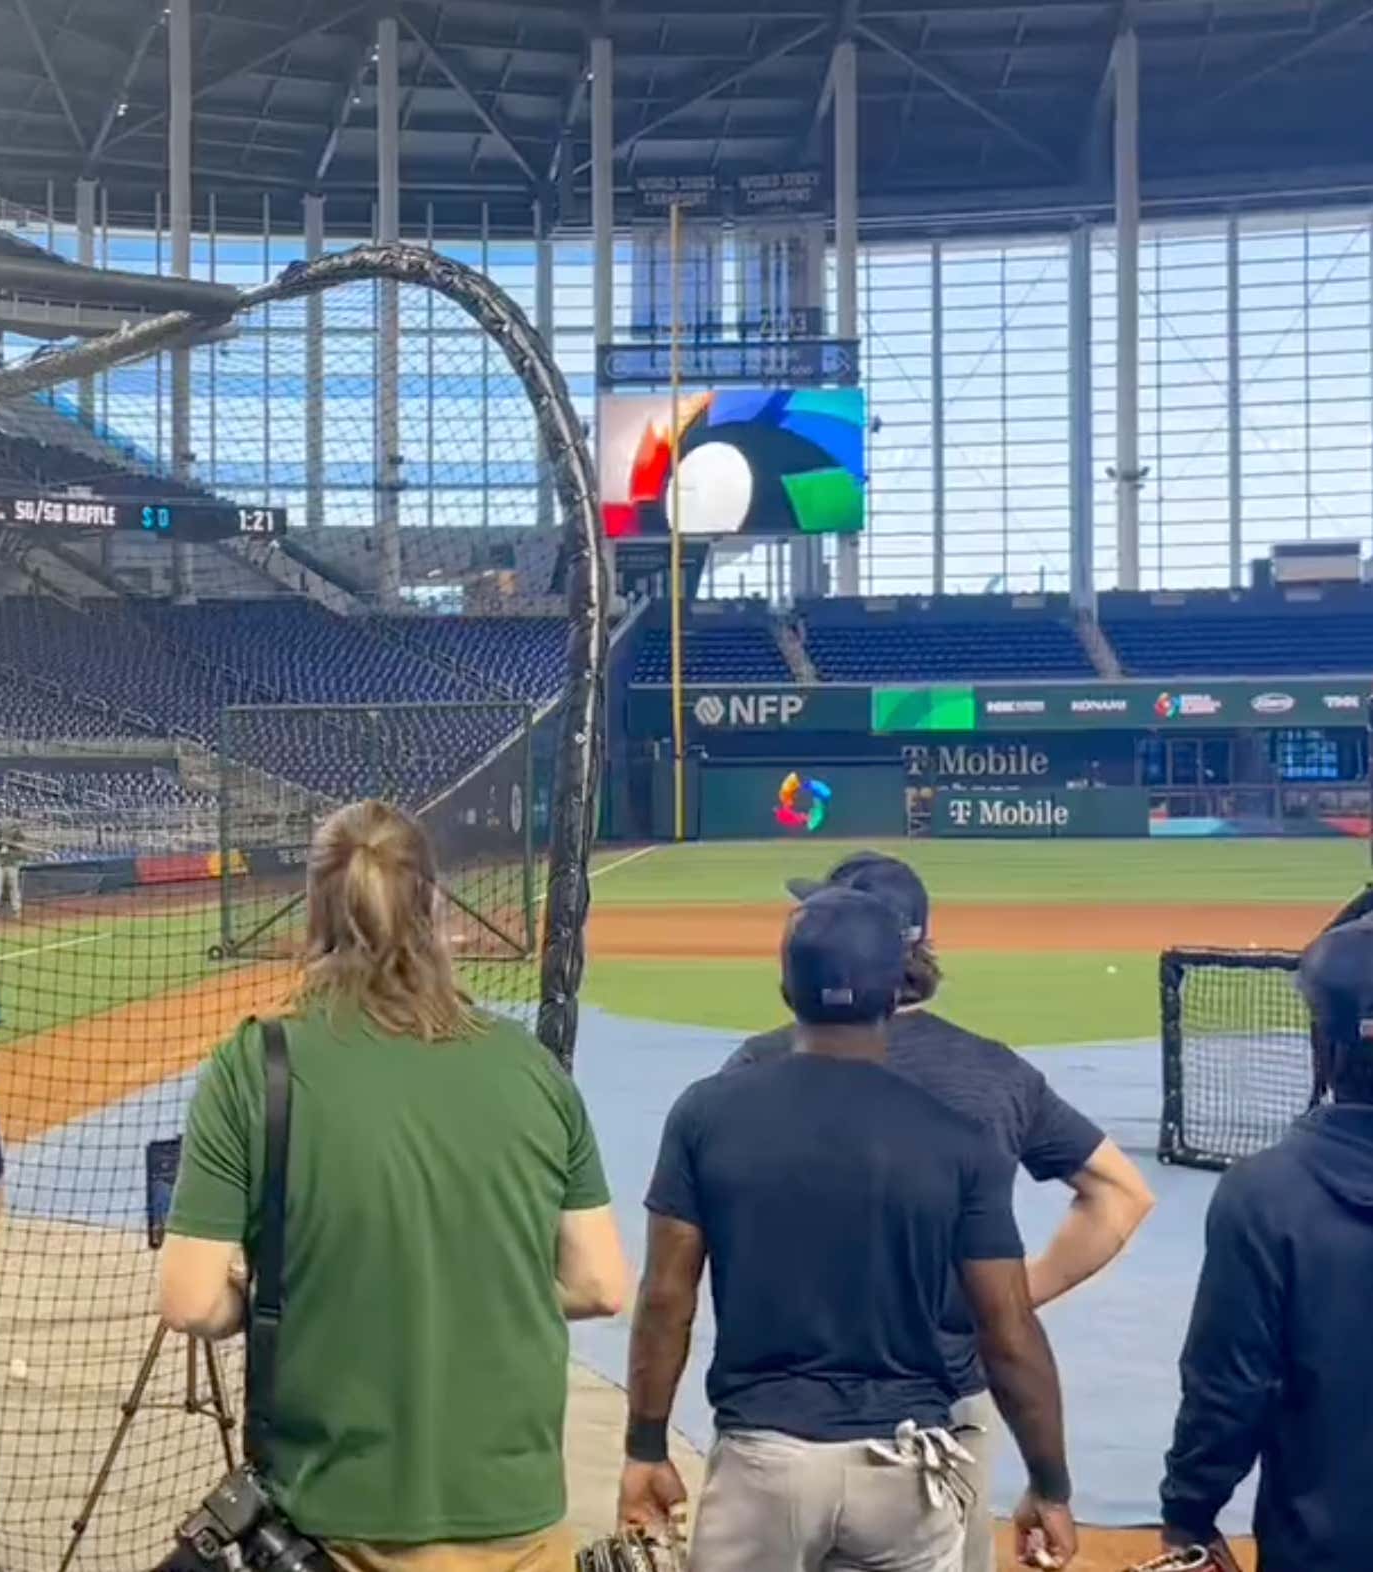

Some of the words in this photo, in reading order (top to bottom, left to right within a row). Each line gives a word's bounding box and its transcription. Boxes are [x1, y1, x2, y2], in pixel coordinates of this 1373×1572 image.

[67, 503, 116, 526] RAFFLE
[238, 509, 275, 532] 1:21
[729, 695, 804, 724] NFP
[939, 745, 1049, 776] Mobile
[980, 799, 1069, 826] Mobile
